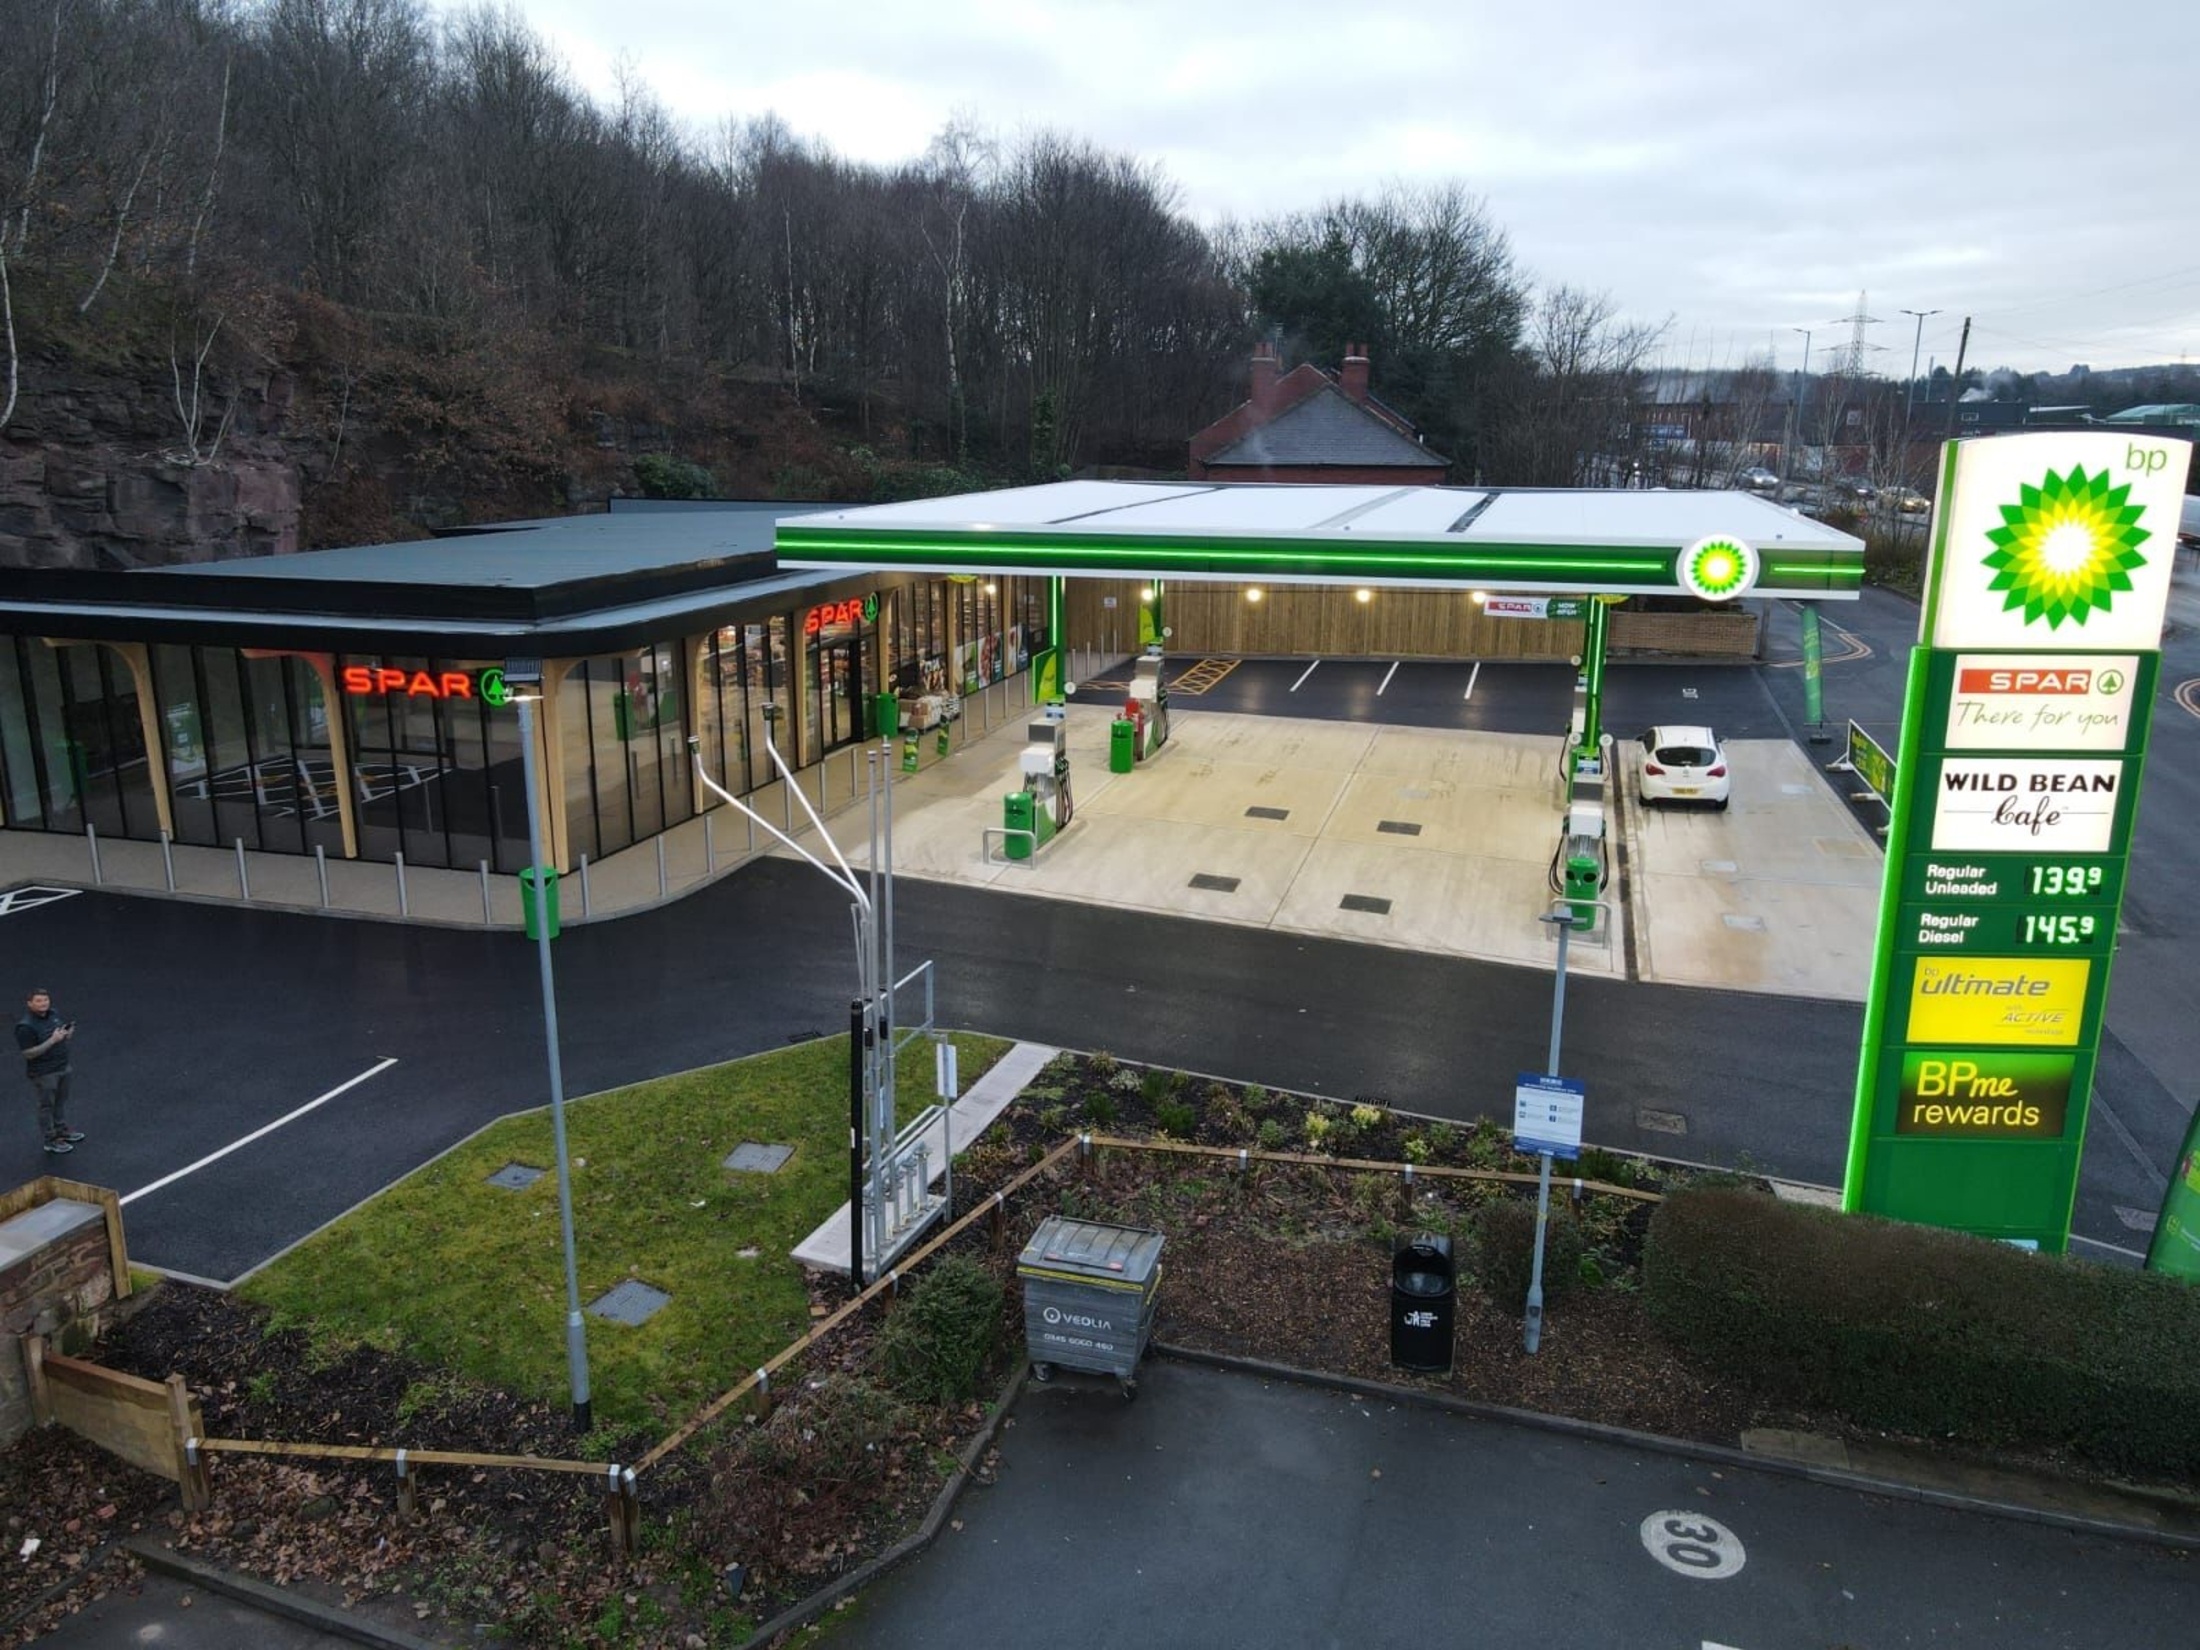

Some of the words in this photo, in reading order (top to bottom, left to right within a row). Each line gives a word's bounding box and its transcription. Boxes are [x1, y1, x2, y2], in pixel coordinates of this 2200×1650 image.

[2125, 442, 2168, 477] bp
[804, 597, 863, 635] SPAR
[1497, 602, 1532, 612] SPAR
[344, 667, 472, 699] SPAR
[1989, 671, 2089, 691] SPAR
[1956, 700, 2023, 726] There
[2029, 702, 2072, 732] for
[2077, 712, 2119, 735] you
[1944, 773, 2018, 792] WILD
[2029, 774, 2116, 793] BEAN
[1927, 864, 1987, 880] Regular
[1925, 881, 1998, 896] Unleaded
[1920, 913, 1980, 929] Regular
[1917, 930, 1965, 944] Diesel
[1920, 973, 2051, 997] ultimate
[2001, 1011, 2066, 1024] ACTIVE
[1916, 1060, 2019, 1098] BPme
[1913, 1100, 2041, 1127] rewards
[1062, 1312, 1112, 1331] VEOLIA
[1664, 1519, 1722, 1569] 30
